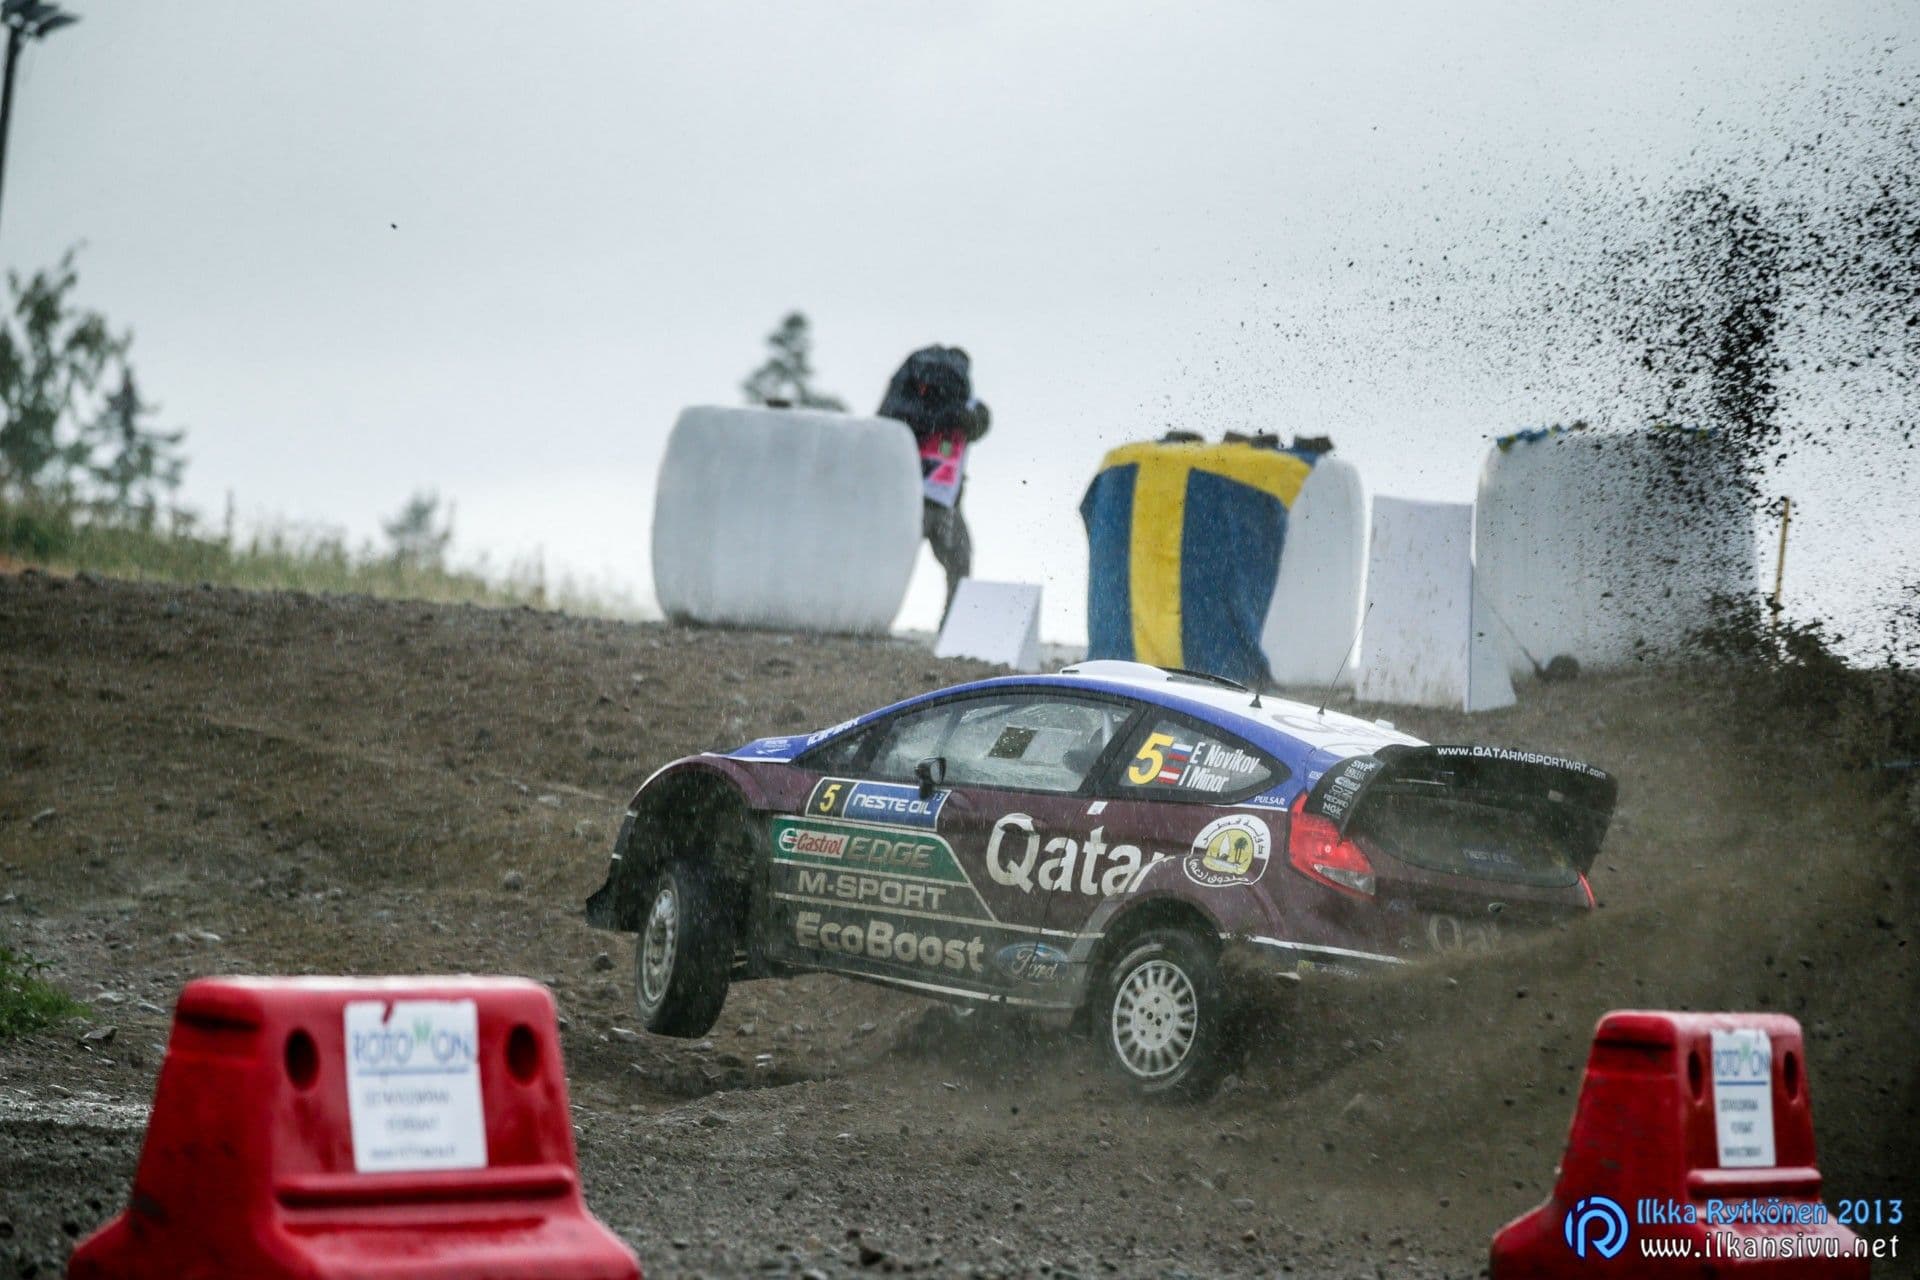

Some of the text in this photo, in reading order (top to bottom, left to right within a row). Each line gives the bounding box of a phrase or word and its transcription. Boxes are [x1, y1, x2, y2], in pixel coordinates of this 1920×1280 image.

[1128, 732, 1174, 785] 5
[1189, 741, 1261, 774] E Novikov
[1437, 746, 1607, 781] www.QATARMSPORTWRT.com
[1187, 766, 1230, 793] Minor
[819, 783, 842, 813] 5
[852, 793, 932, 815] NESTE OIL
[1254, 794, 1286, 806] PULSAR
[1322, 801, 1343, 816] NGK
[797, 832, 936, 868] Castrol EDGE
[986, 812, 1176, 897] Qatar
[797, 870, 947, 909] M-SPORT
[796, 911, 985, 973] EcoBoost
[1011, 948, 1060, 978] Ford
